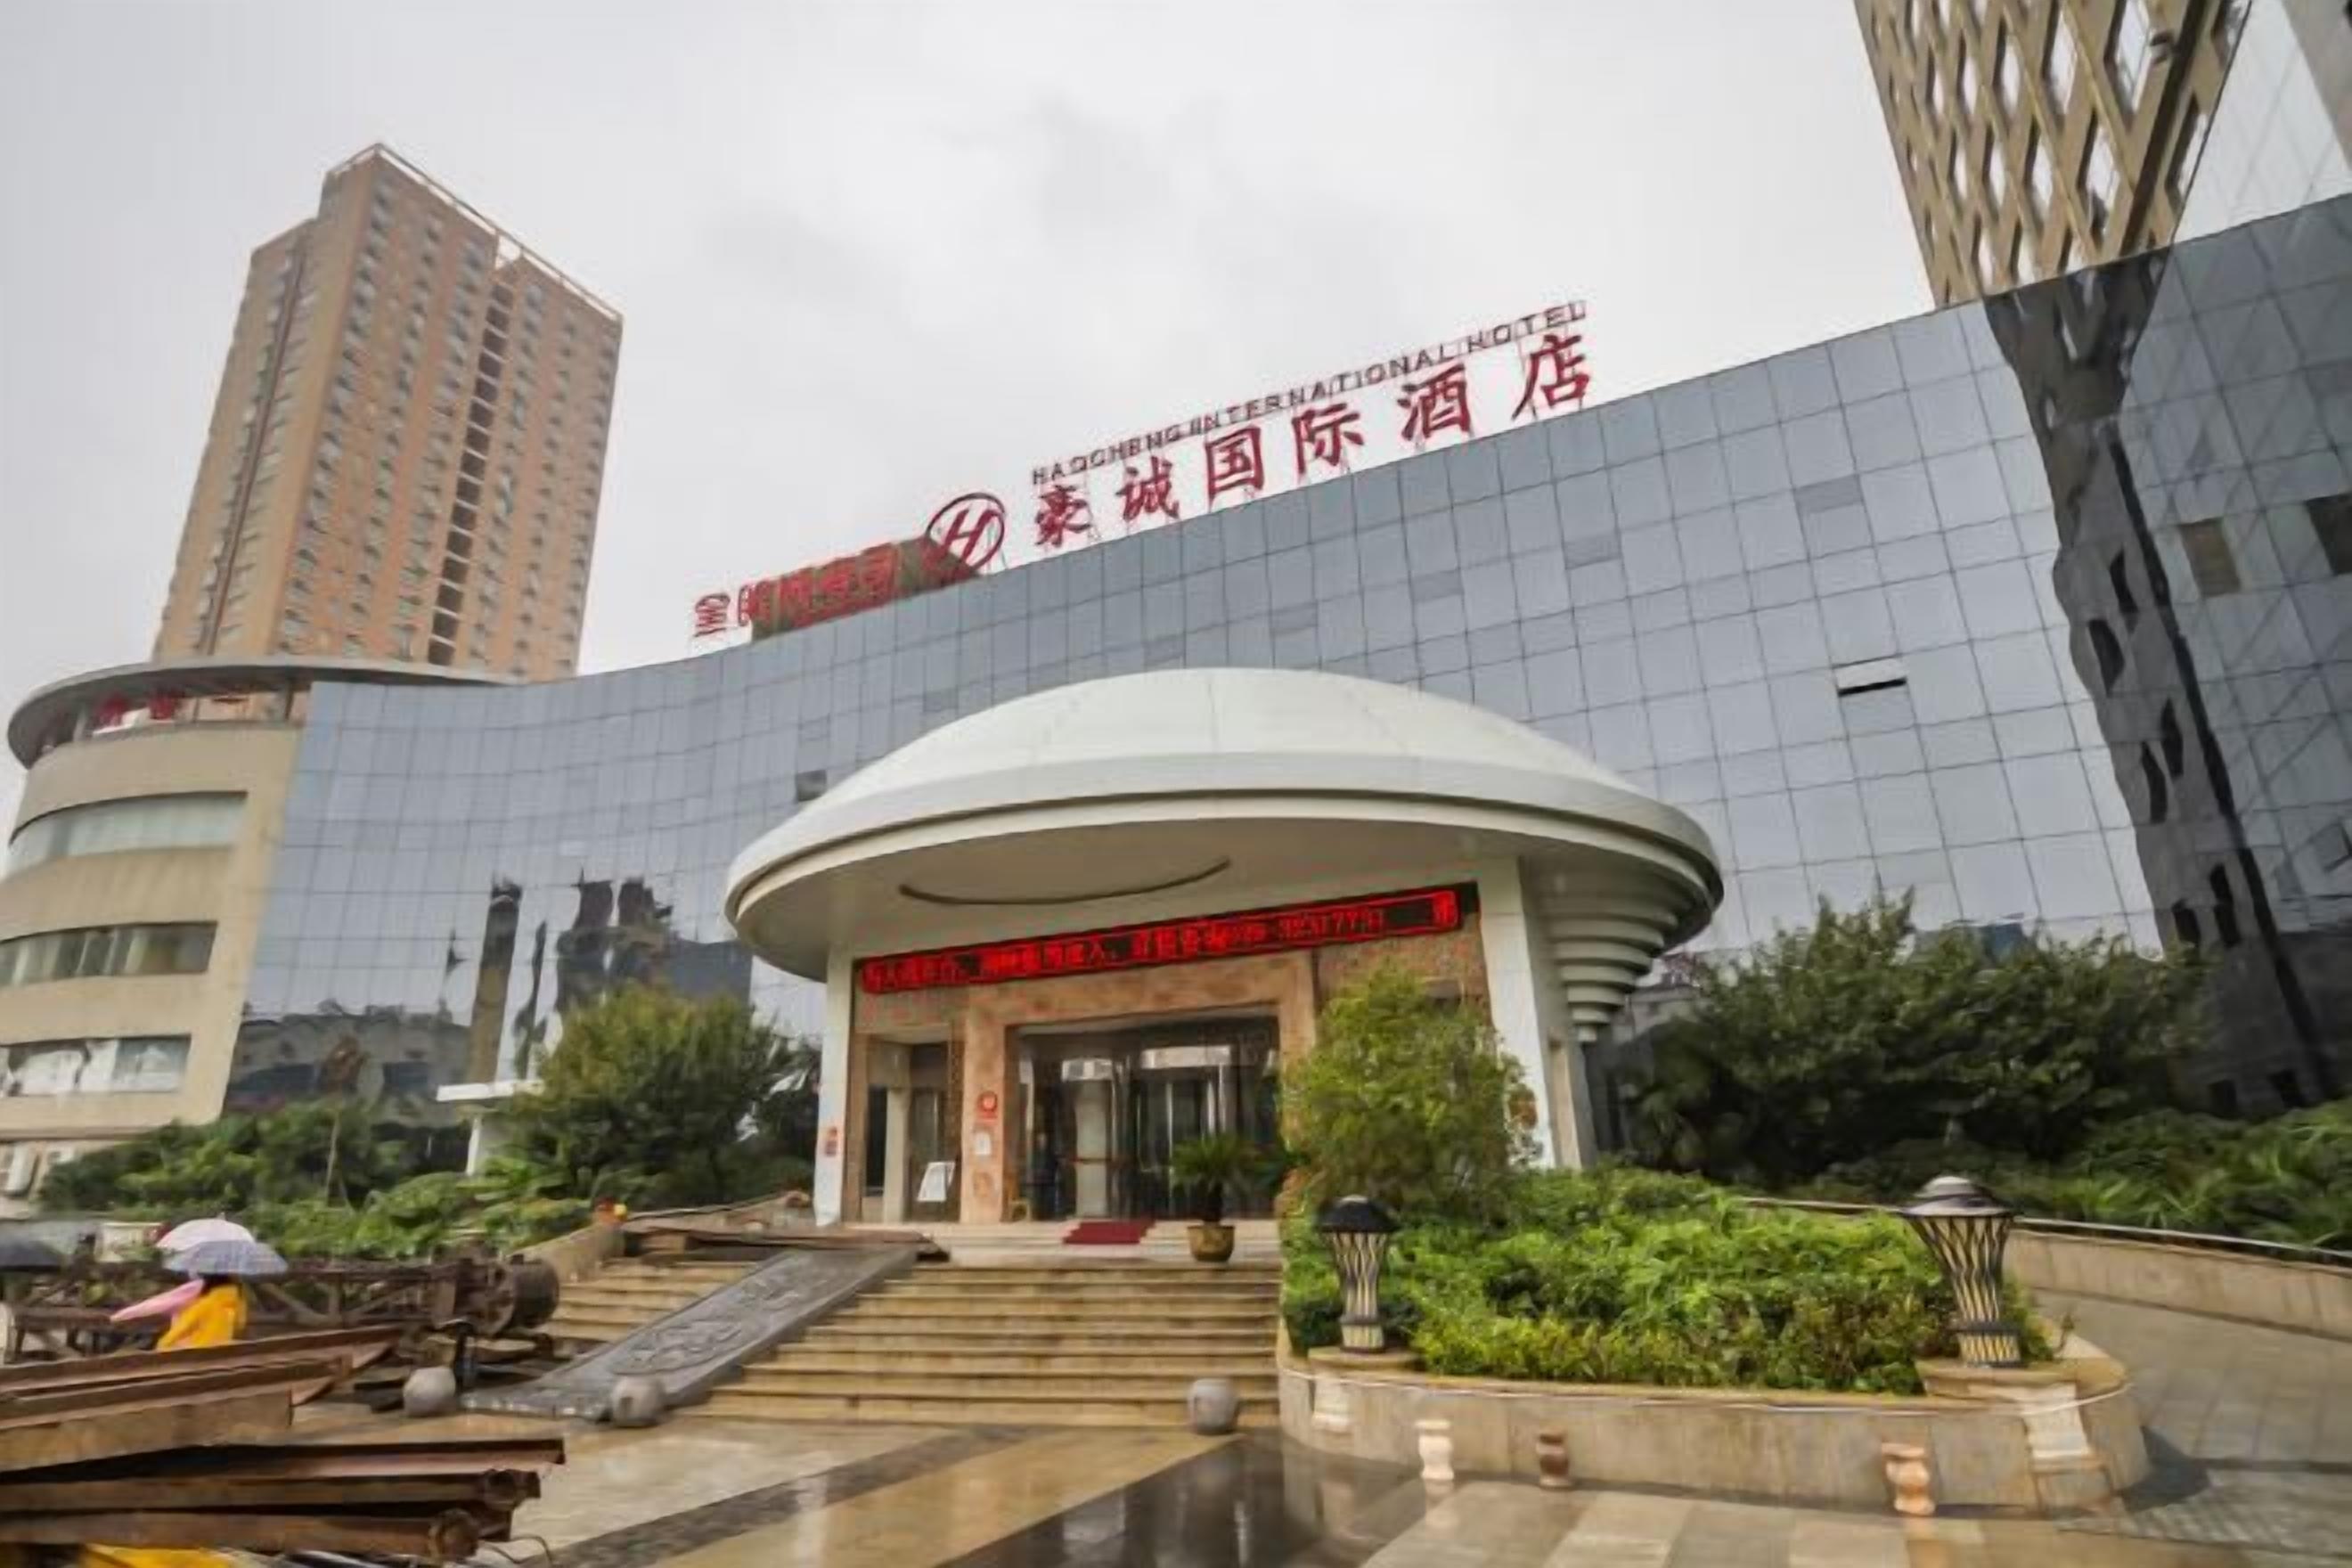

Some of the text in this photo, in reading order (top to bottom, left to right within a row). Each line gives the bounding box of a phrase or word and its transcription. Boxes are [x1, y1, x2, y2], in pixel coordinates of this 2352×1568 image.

[1467, 299, 1587, 355] HOTEL
[1033, 333, 1590, 549] 豪诚国际酒店
